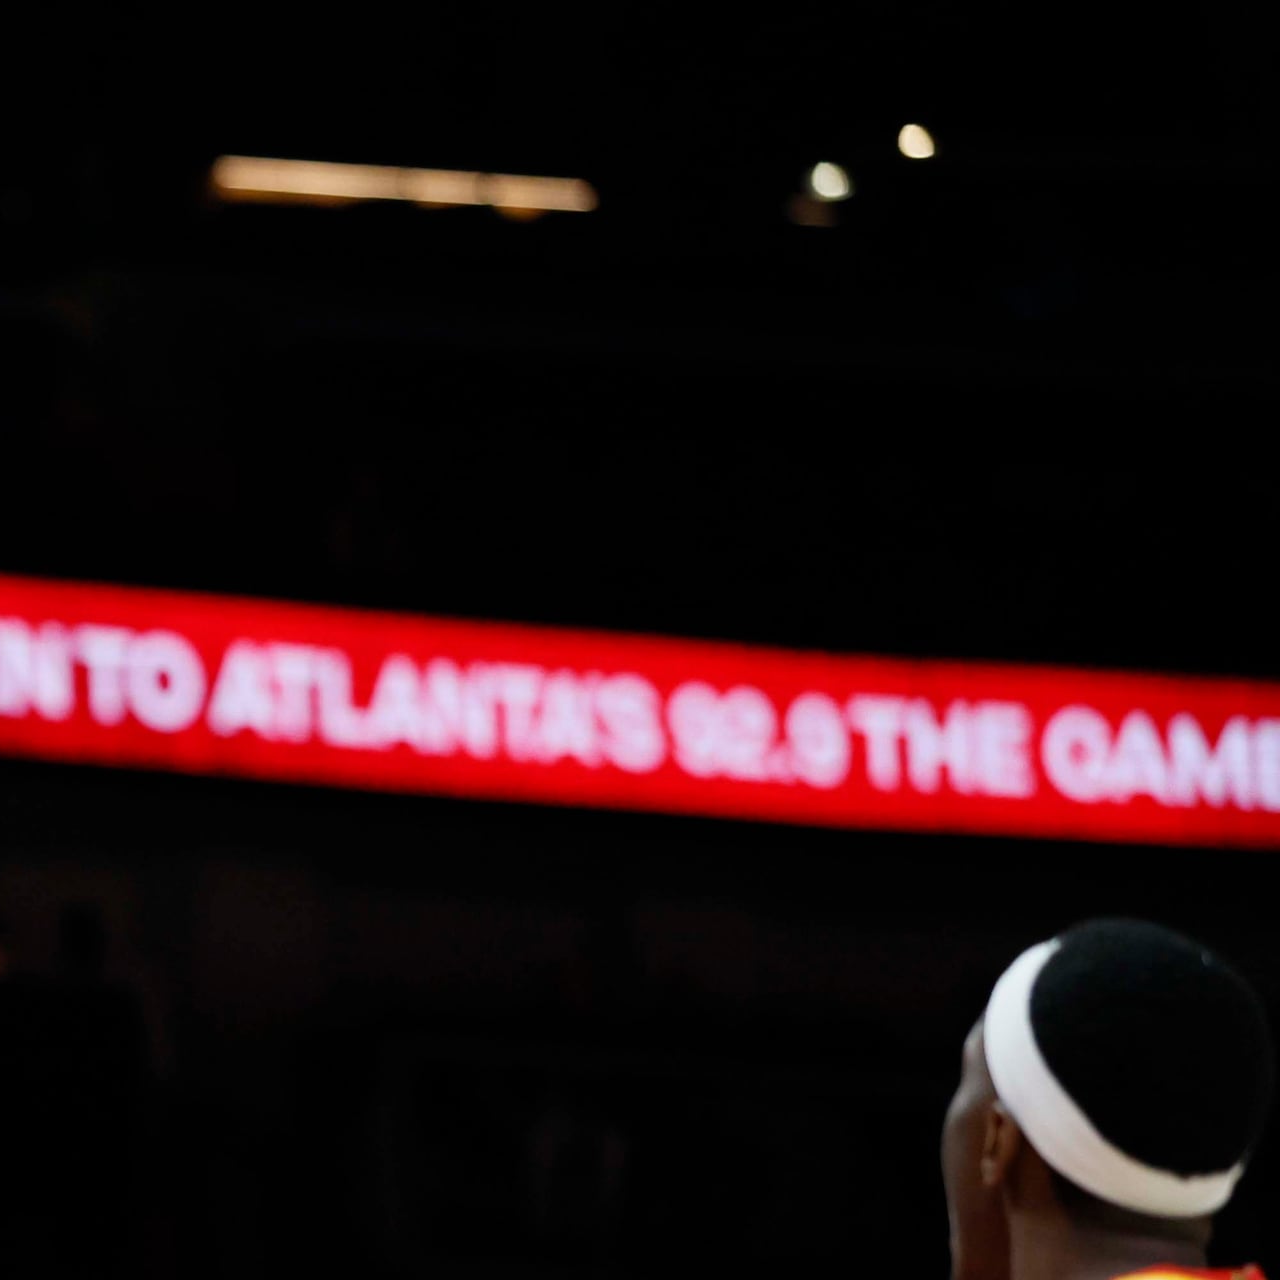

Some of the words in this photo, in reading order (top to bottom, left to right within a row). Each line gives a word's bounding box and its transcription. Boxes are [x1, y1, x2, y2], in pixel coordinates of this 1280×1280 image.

[73, 624, 209, 733] TO
[206, 638, 666, 774] ATLANTA'S
[845, 692, 1037, 799] THE
